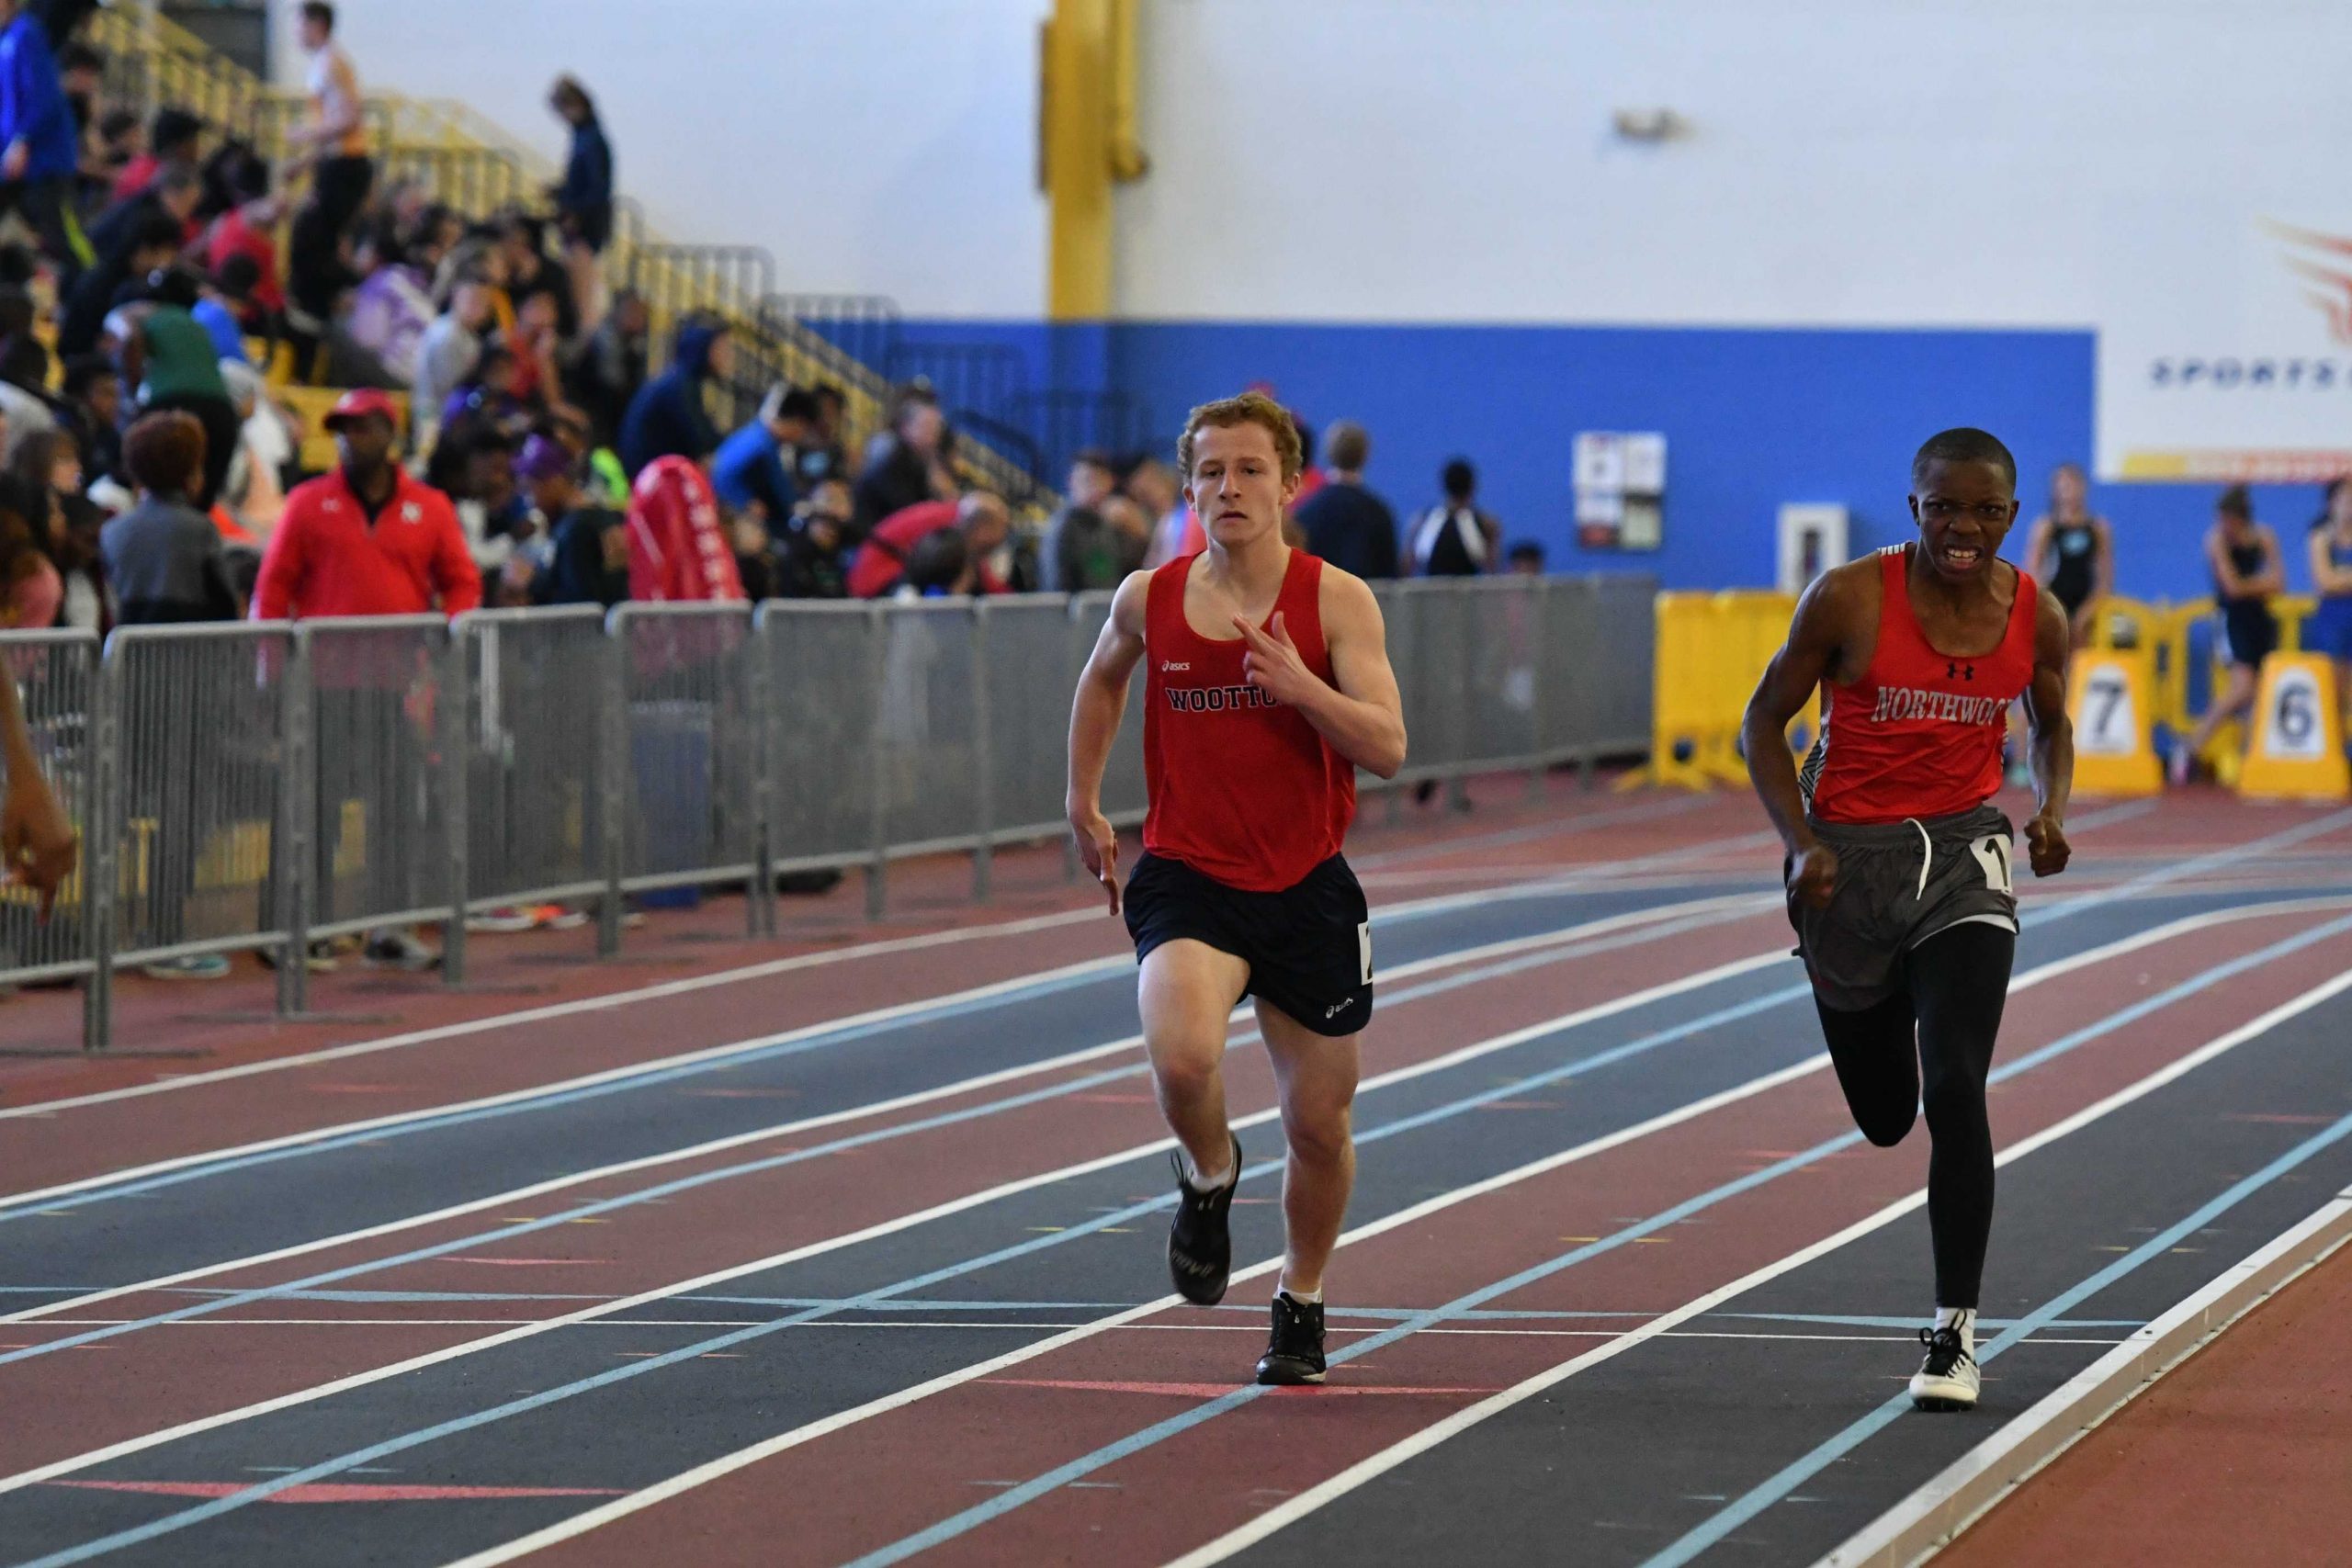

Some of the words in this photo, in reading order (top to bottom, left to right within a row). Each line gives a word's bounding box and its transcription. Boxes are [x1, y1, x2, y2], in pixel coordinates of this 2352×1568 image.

[2150, 355, 2336, 389] SPORTS
[2089, 678, 2127, 740] 7
[2276, 678, 2315, 748] 6
